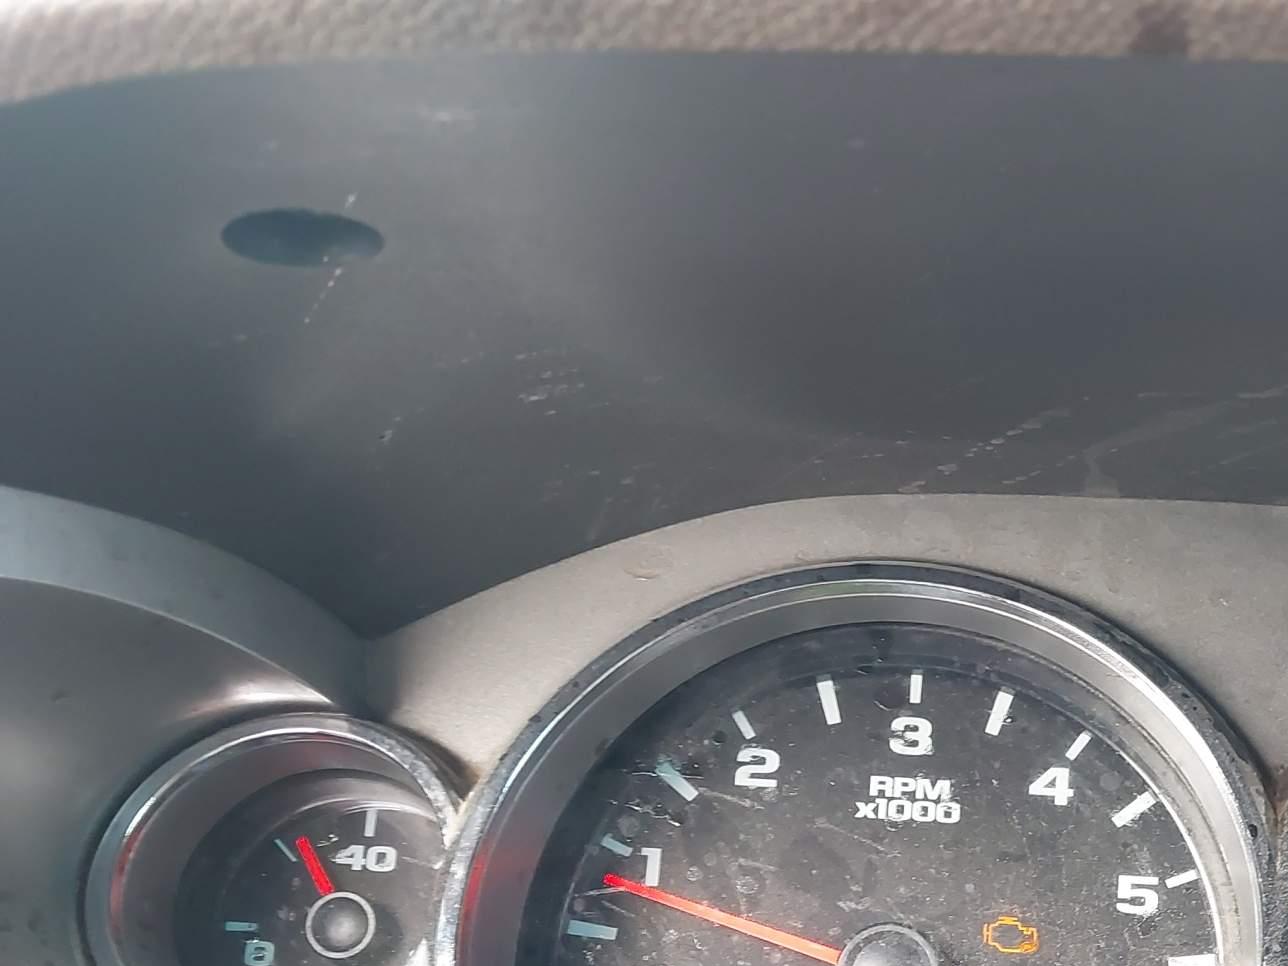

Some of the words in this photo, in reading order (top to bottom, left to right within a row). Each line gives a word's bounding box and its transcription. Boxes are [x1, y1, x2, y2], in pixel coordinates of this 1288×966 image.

[889, 716, 934, 757] 3
[734, 747, 781, 789] 2
[868, 776, 952, 799] RPM
[1028, 767, 1075, 806] 4
[855, 798, 961, 824] x1000
[335, 844, 397, 872] 40
[638, 847, 661, 887] 1
[1116, 874, 1159, 914] 5
